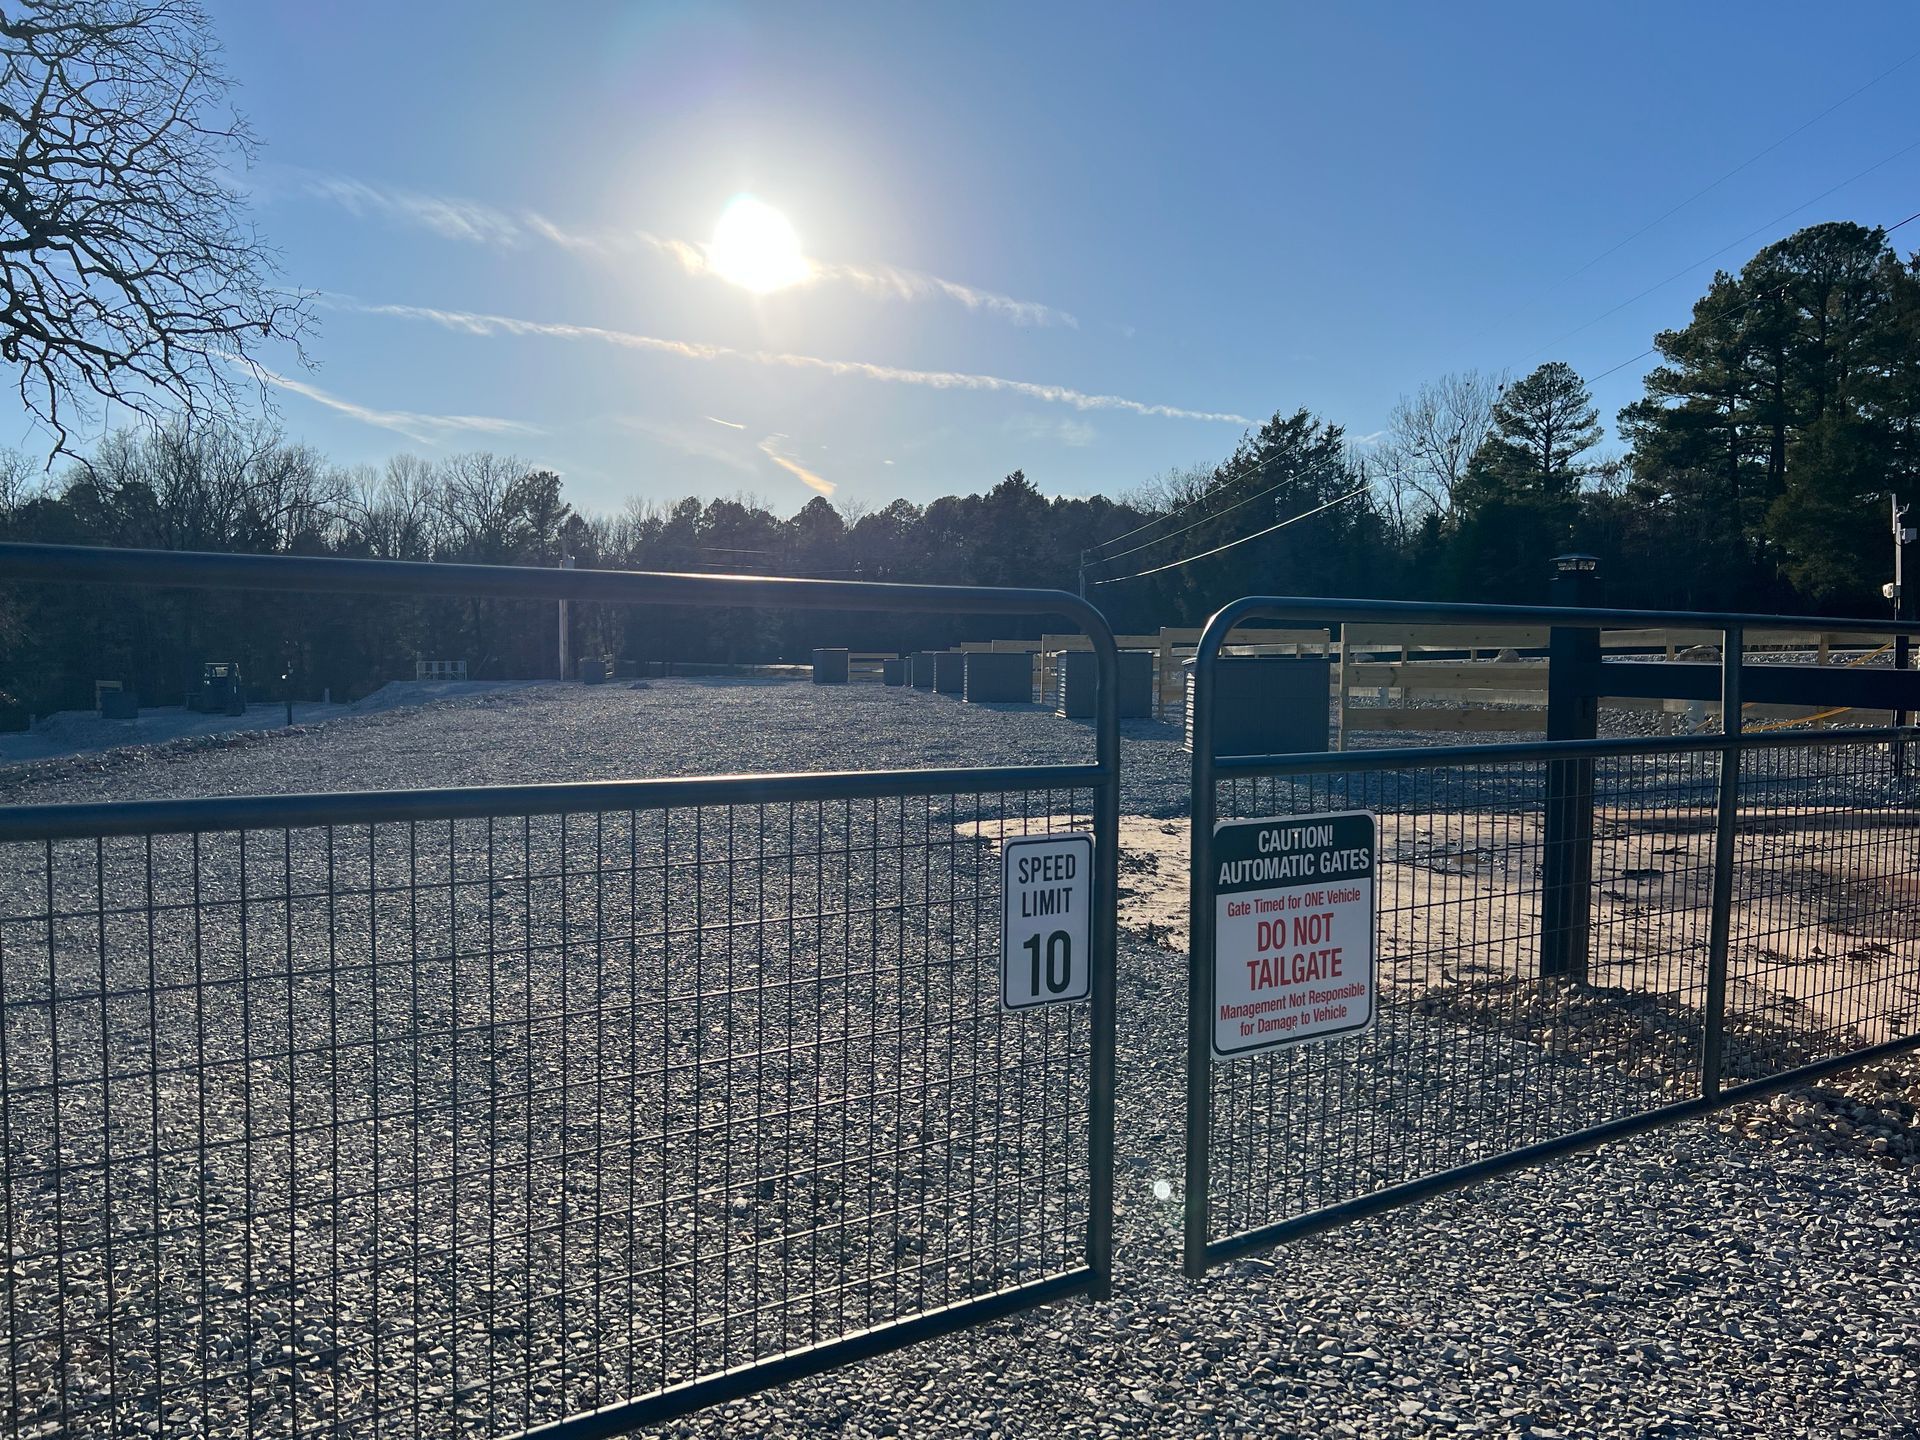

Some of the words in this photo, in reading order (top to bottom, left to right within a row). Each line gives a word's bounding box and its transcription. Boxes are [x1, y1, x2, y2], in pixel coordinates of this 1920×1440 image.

[1259, 825, 1333, 852] CAUTION!
[1018, 854, 1076, 884] SPEED
[1219, 855, 1315, 884] AUTOMATIC
[1320, 848, 1369, 874] GATES
[1022, 888, 1072, 917] LIMIT
[1228, 901, 1250, 917] Gate
[1254, 896, 1284, 913] Timed
[1288, 894, 1302, 909] for
[1305, 892, 1324, 907] ONE
[1327, 888, 1360, 904] Vehicle
[1258, 918, 1286, 952] DO
[1294, 913, 1334, 947] NOT
[1023, 930, 1071, 996] 10
[1247, 948, 1342, 991] TAILGATE
[1221, 998, 1286, 1020] Management
[1290, 993, 1306, 1007] Not
[1309, 983, 1365, 1005] Responsible
[1240, 1022, 1255, 1036] for
[1258, 1015, 1297, 1033] Damage
[1301, 1010, 1310, 1024] to
[1313, 1004, 1347, 1021] Vehicle
